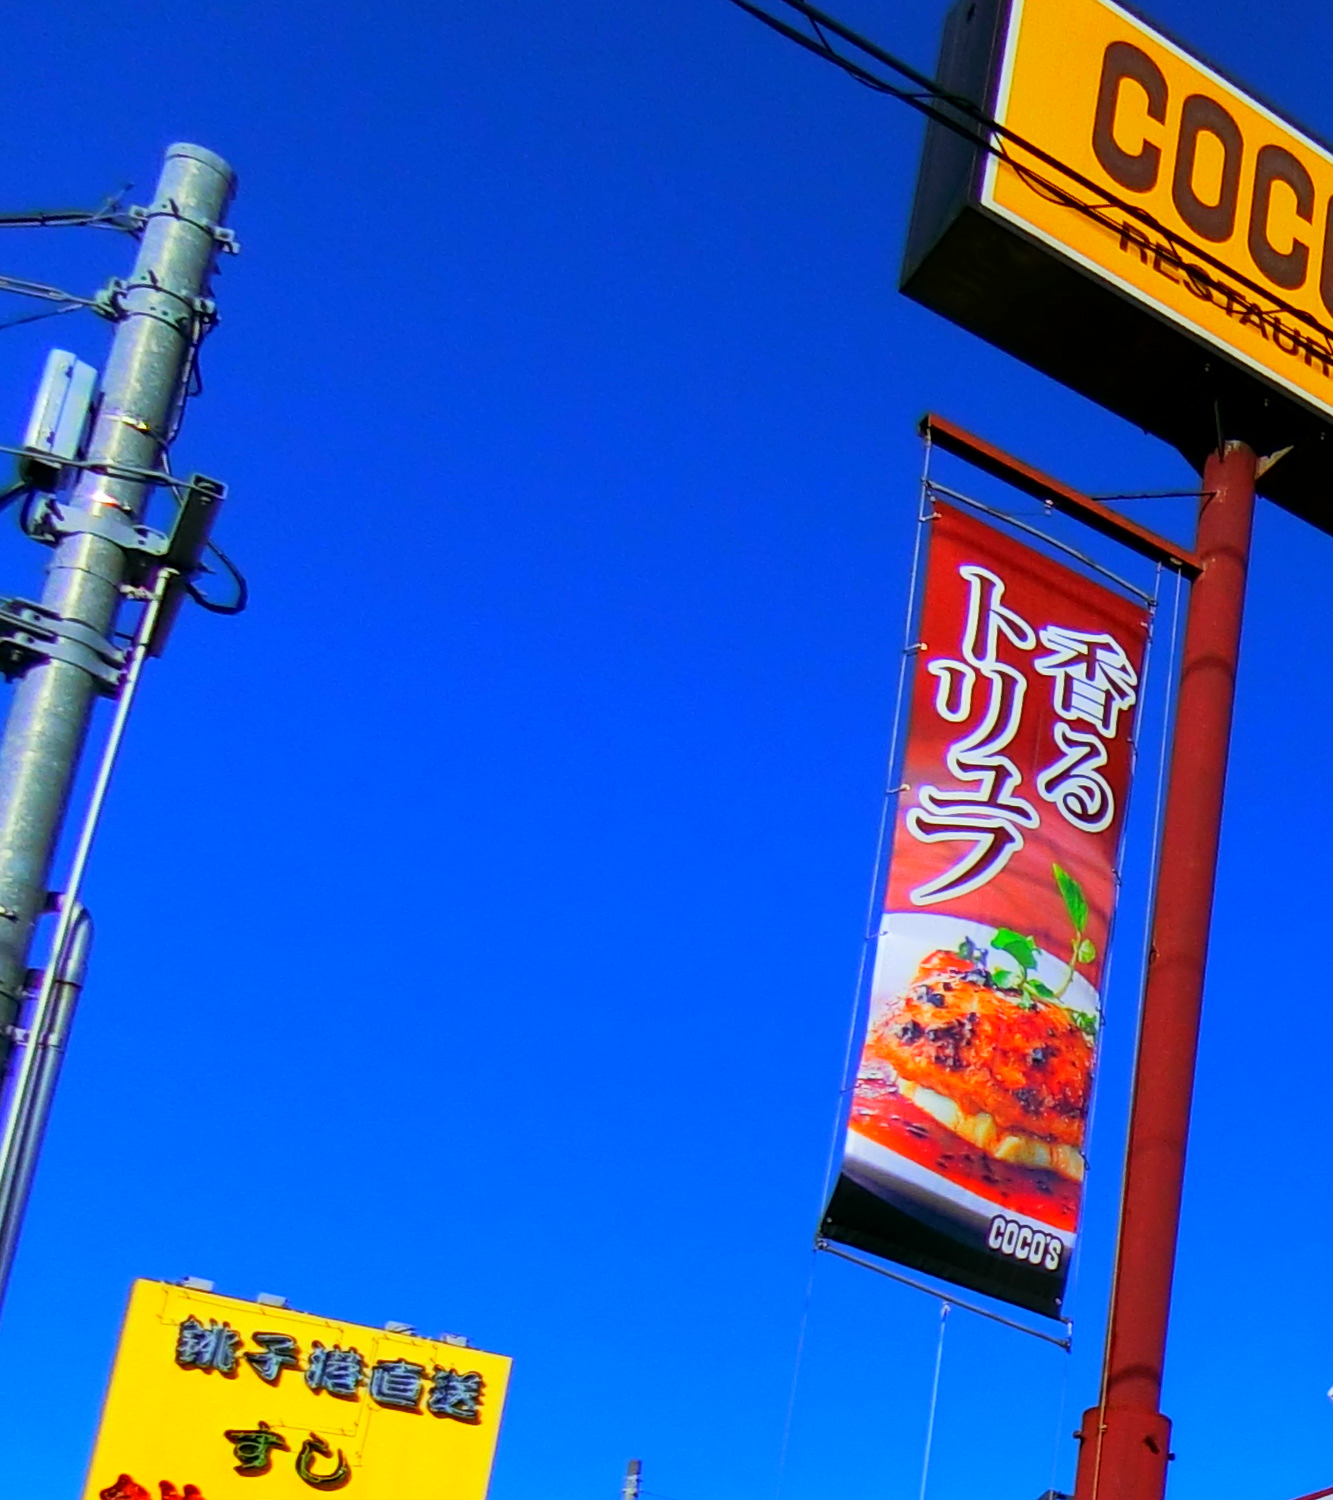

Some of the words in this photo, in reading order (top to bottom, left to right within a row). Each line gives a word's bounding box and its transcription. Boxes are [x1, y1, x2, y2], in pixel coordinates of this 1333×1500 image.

[905, 563, 1041, 906] トリュフ
[1034, 625, 1139, 833] 香る
[988, 1214, 1064, 1271] COCO'S
[174, 1313, 488, 1426] 銚子港直送
[223, 1420, 352, 1491] すし
